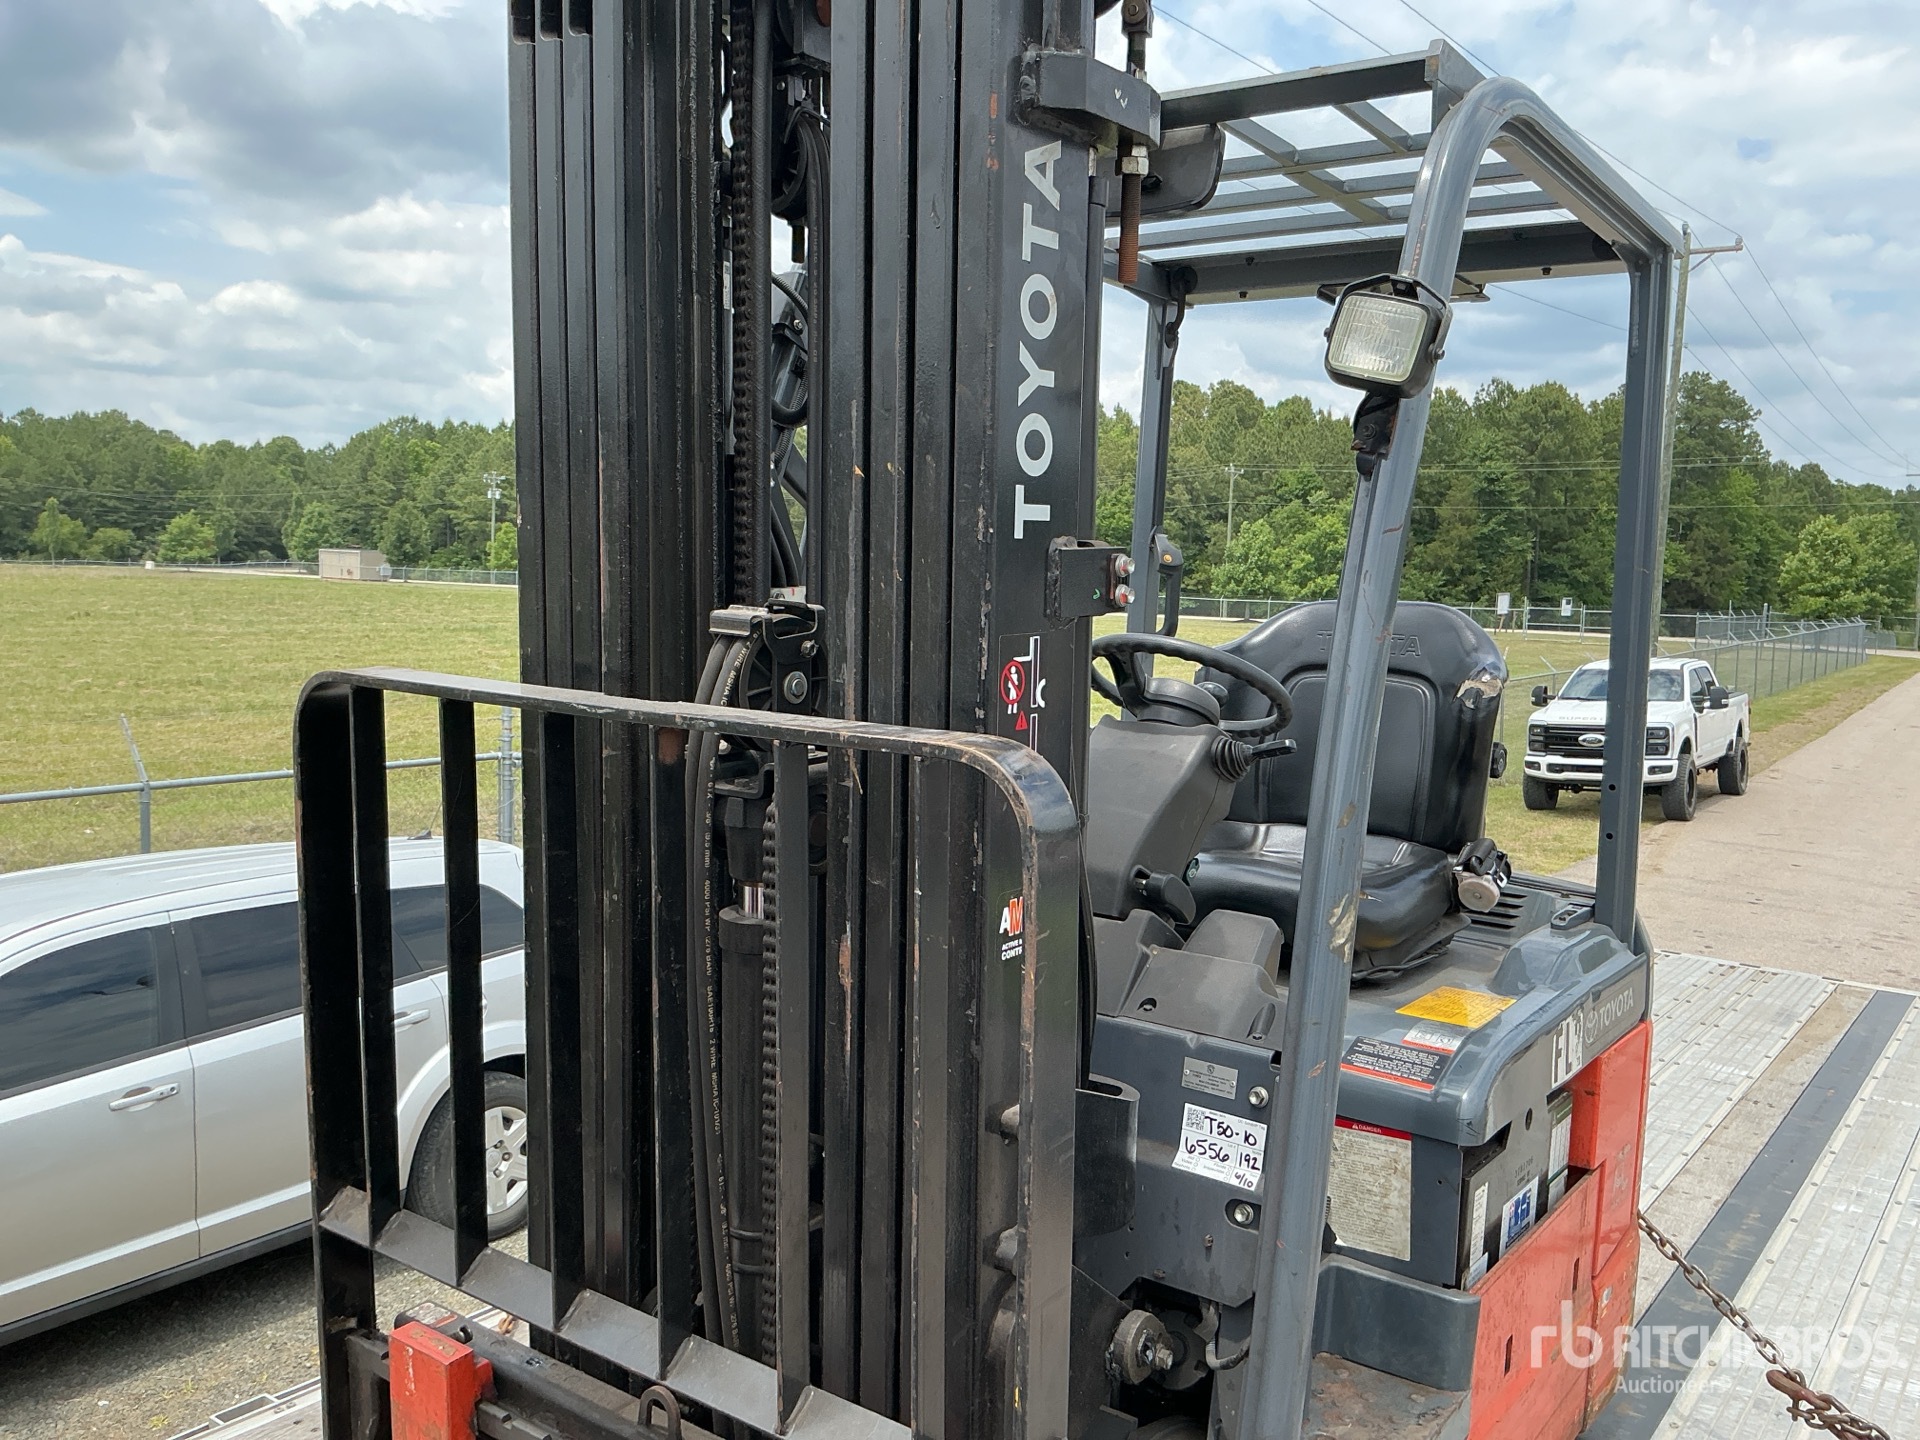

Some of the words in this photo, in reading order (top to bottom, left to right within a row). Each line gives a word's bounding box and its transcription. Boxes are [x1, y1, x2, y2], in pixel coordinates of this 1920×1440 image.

[1014, 140, 1062, 539] TOYOTA
[1316, 629, 1421, 657] TTA
[734, 648, 748, 668] WIRE
[1002, 939, 1018, 951] ACTIVE
[1600, 987, 1634, 1031] TOYOTA
[1358, 1124, 1382, 1133] DANGER
[1185, 1136, 1230, 1163] 6556
[1239, 1152, 1260, 1171] 192
